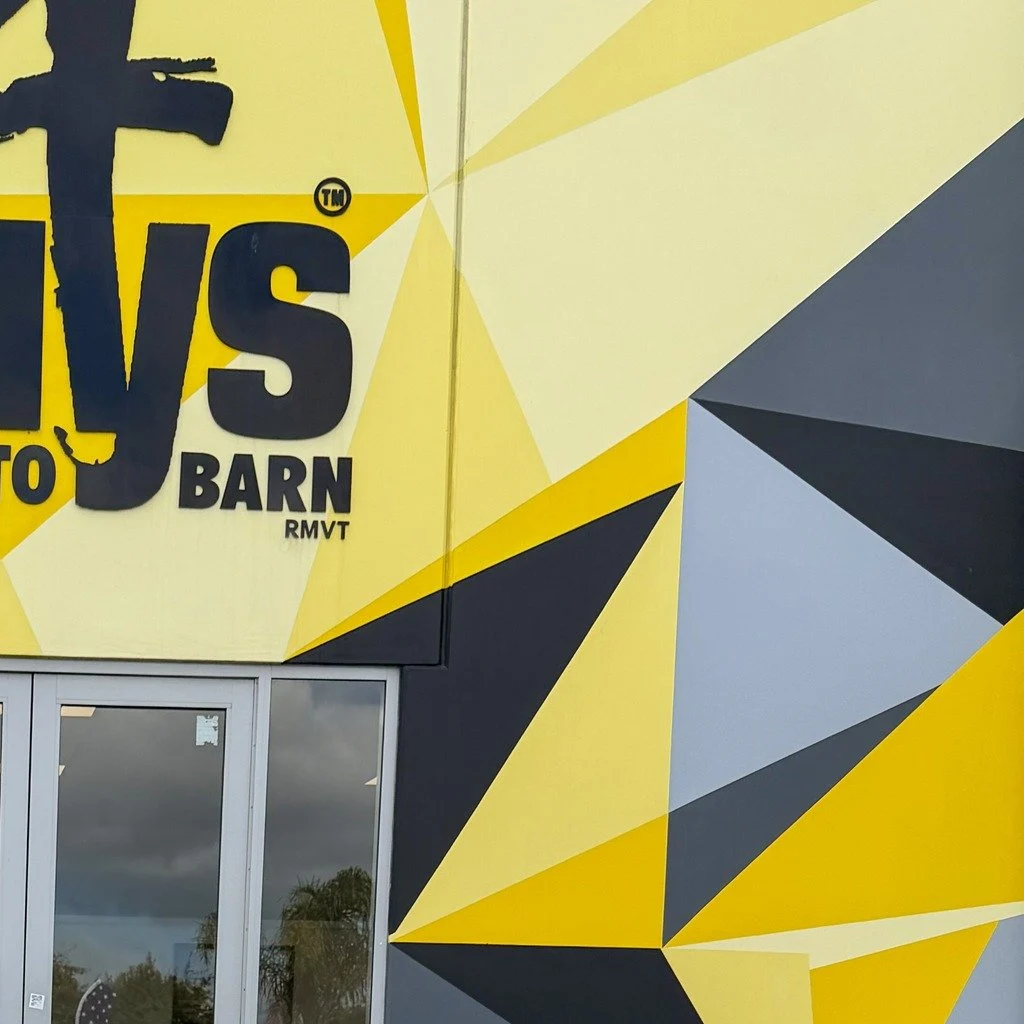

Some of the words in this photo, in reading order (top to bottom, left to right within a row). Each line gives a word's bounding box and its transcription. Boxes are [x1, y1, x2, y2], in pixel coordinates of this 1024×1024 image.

[321, 188, 345, 207] TM
[178, 452, 353, 515] BARN
[284, 518, 350, 541] RMVT
